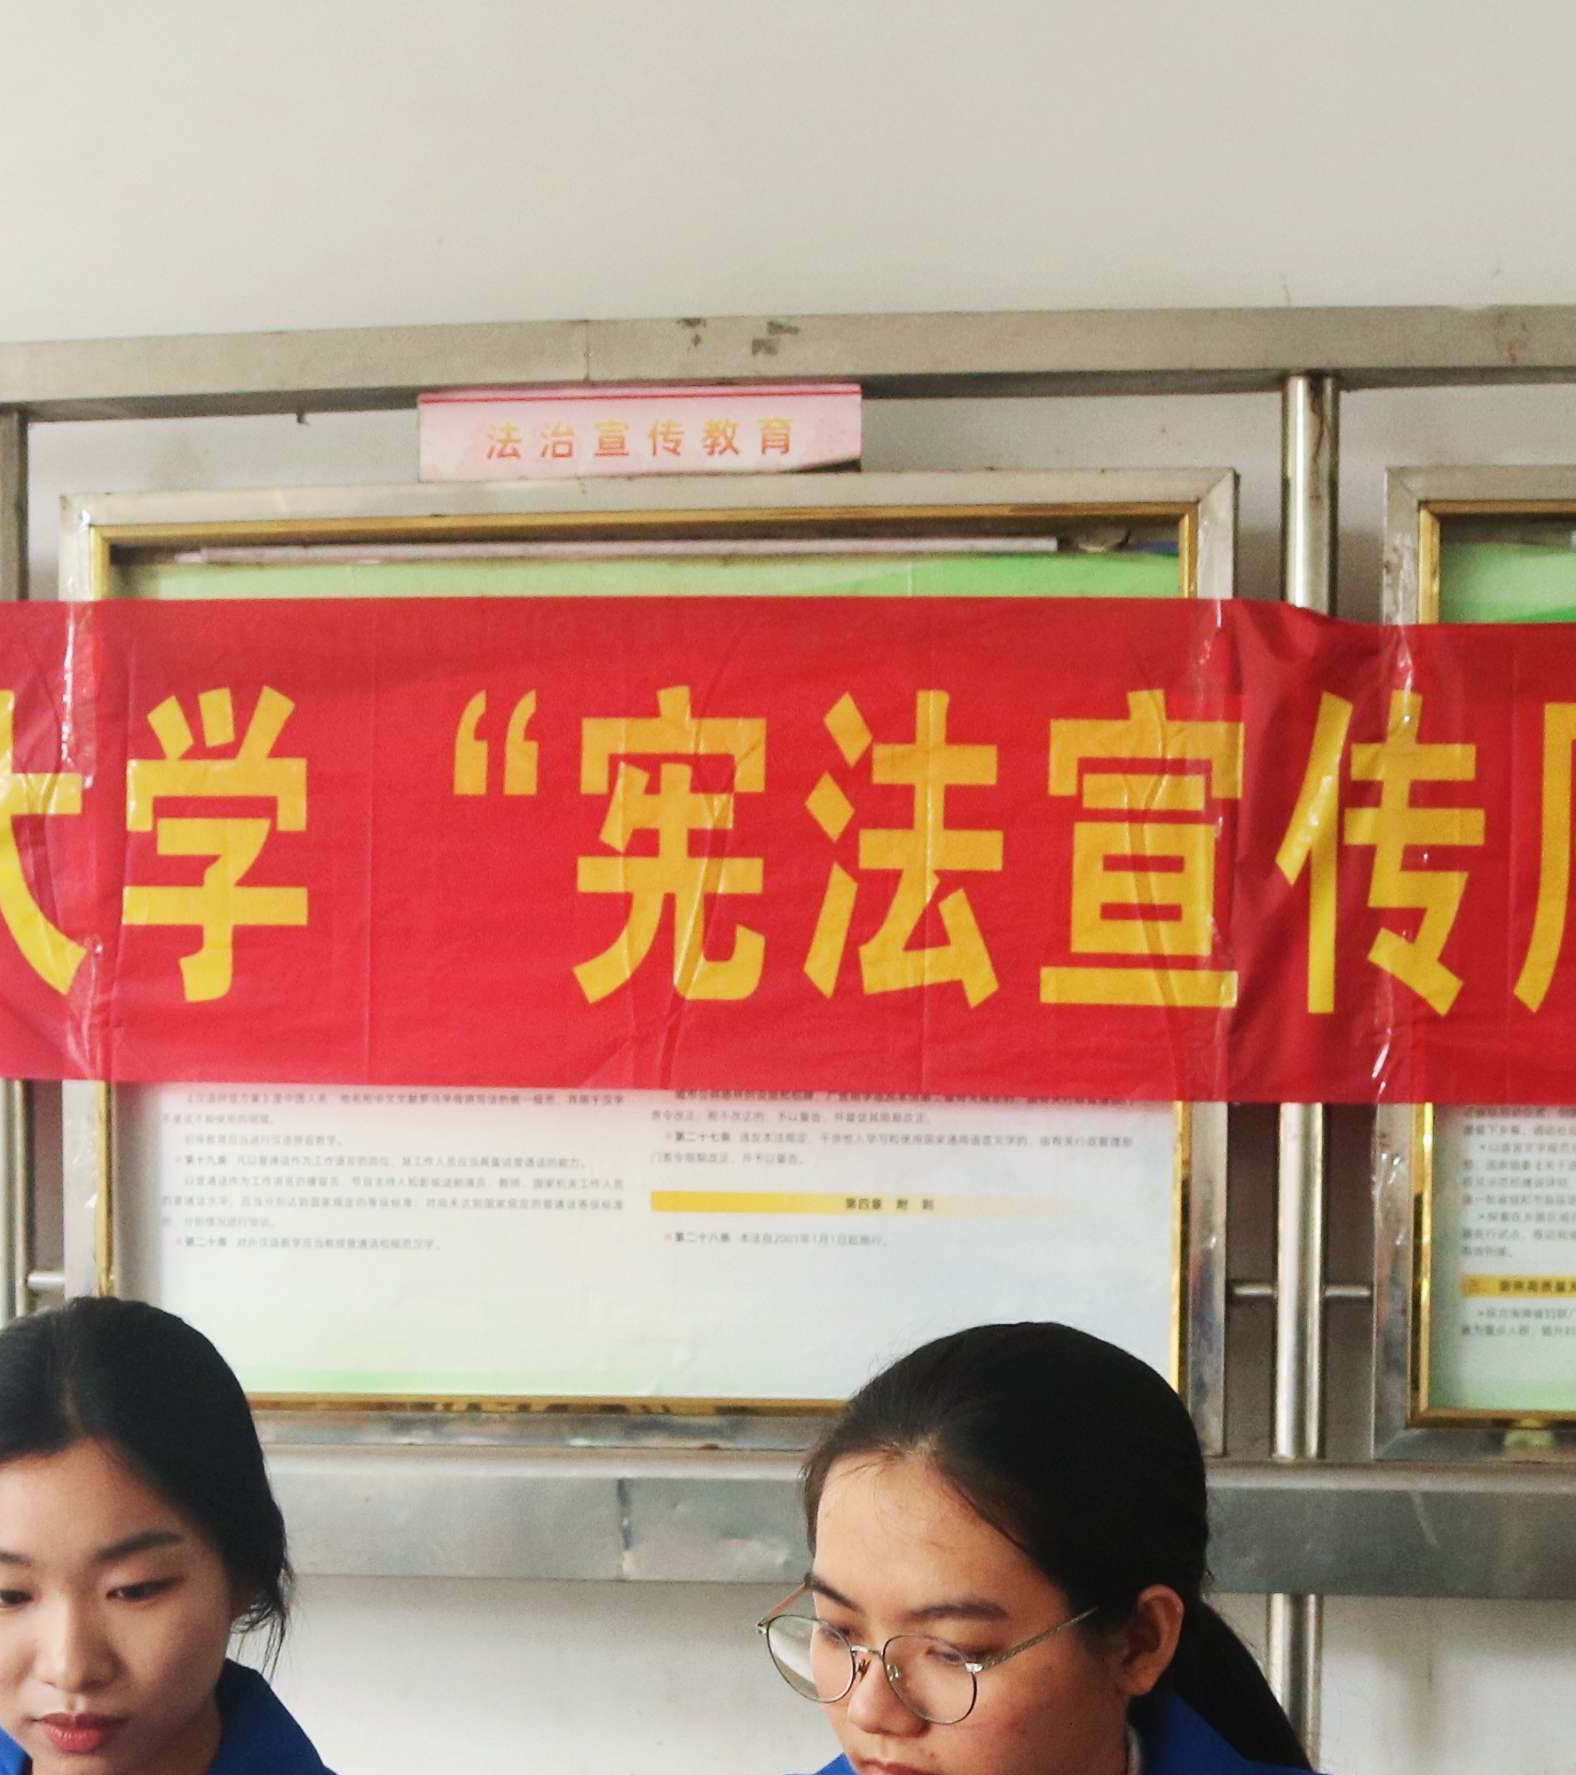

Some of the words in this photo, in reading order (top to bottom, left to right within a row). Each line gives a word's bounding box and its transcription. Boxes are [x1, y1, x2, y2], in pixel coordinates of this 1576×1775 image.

[485, 413, 797, 460] 法治宣传教育
